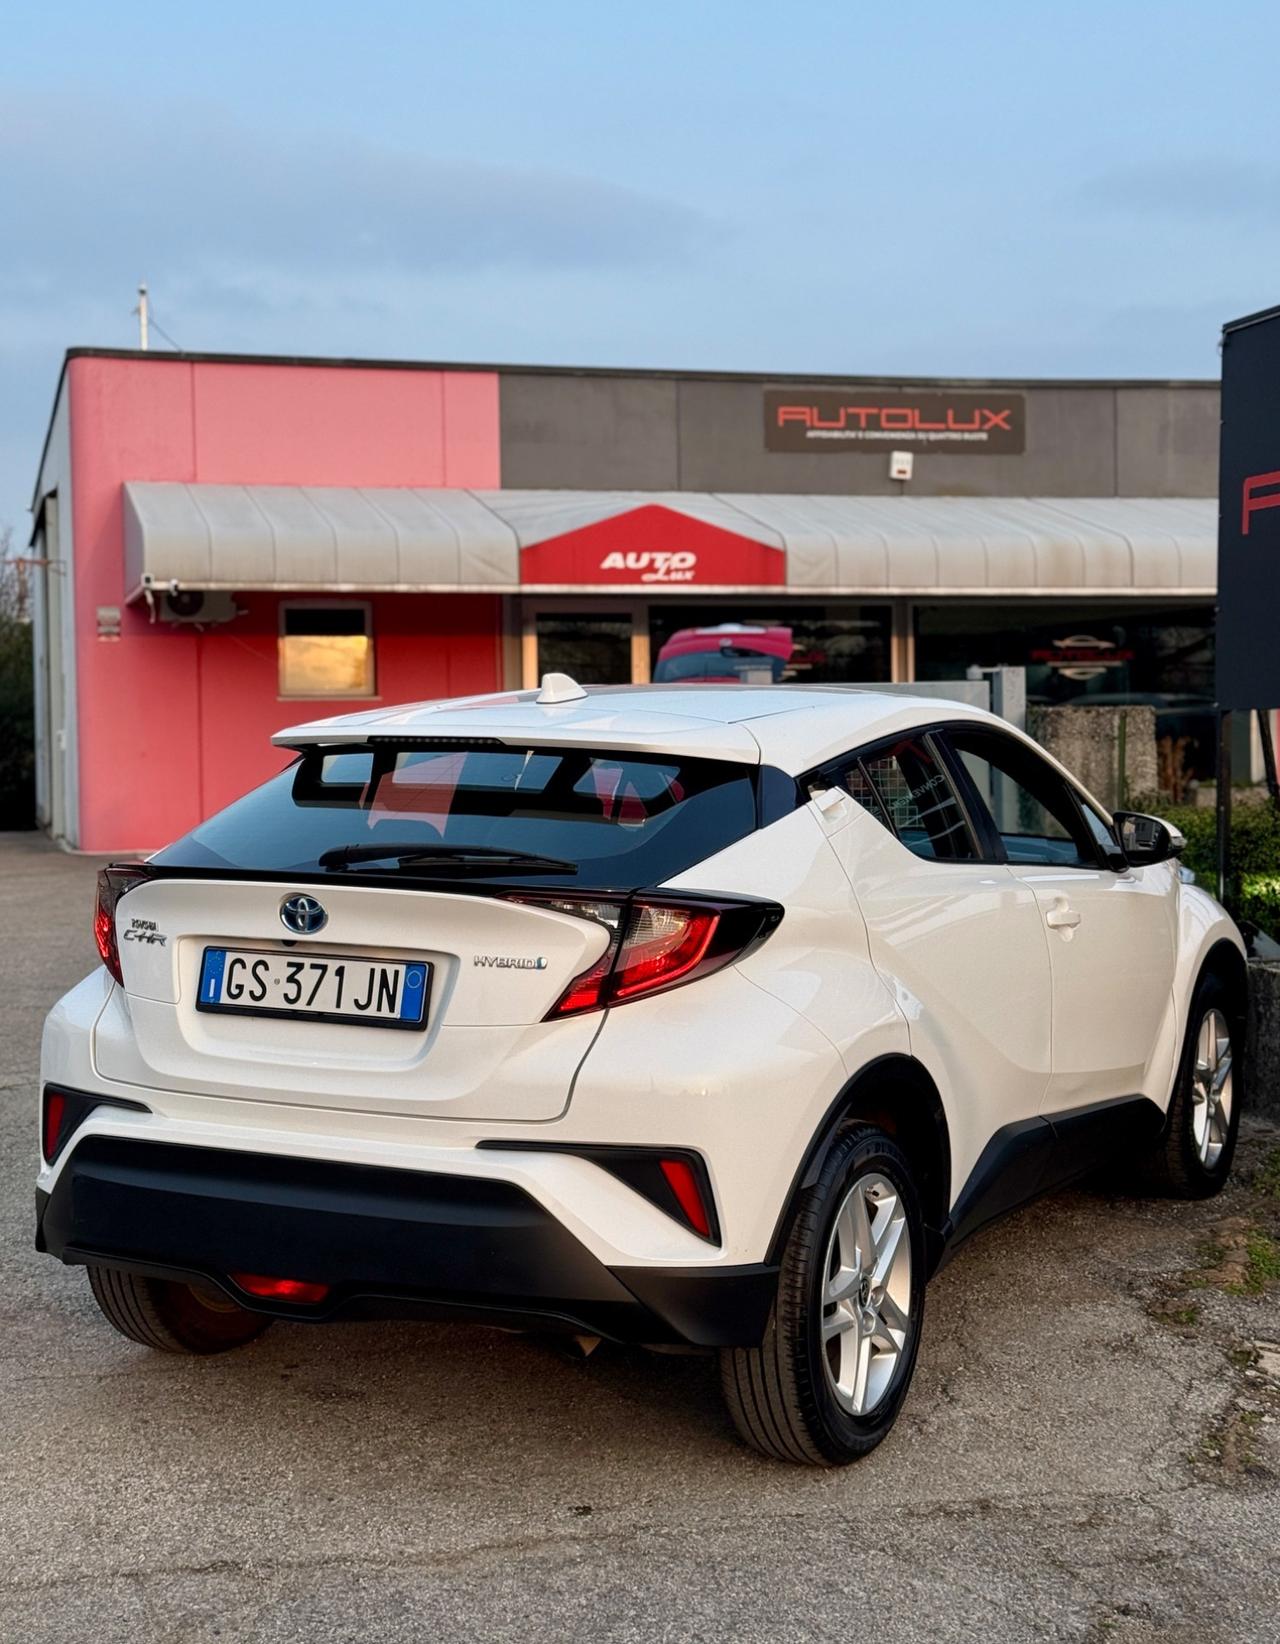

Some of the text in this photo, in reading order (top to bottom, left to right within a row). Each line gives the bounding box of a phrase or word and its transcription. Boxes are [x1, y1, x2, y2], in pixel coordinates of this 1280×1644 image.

[777, 406, 1011, 431] AUTOLUX
[600, 551, 697, 570] AUTO
[474, 955, 536, 969] HYBRID
[226, 957, 270, 1002] GS
[283, 961, 346, 1009] 371
[353, 967, 400, 1013] JN
